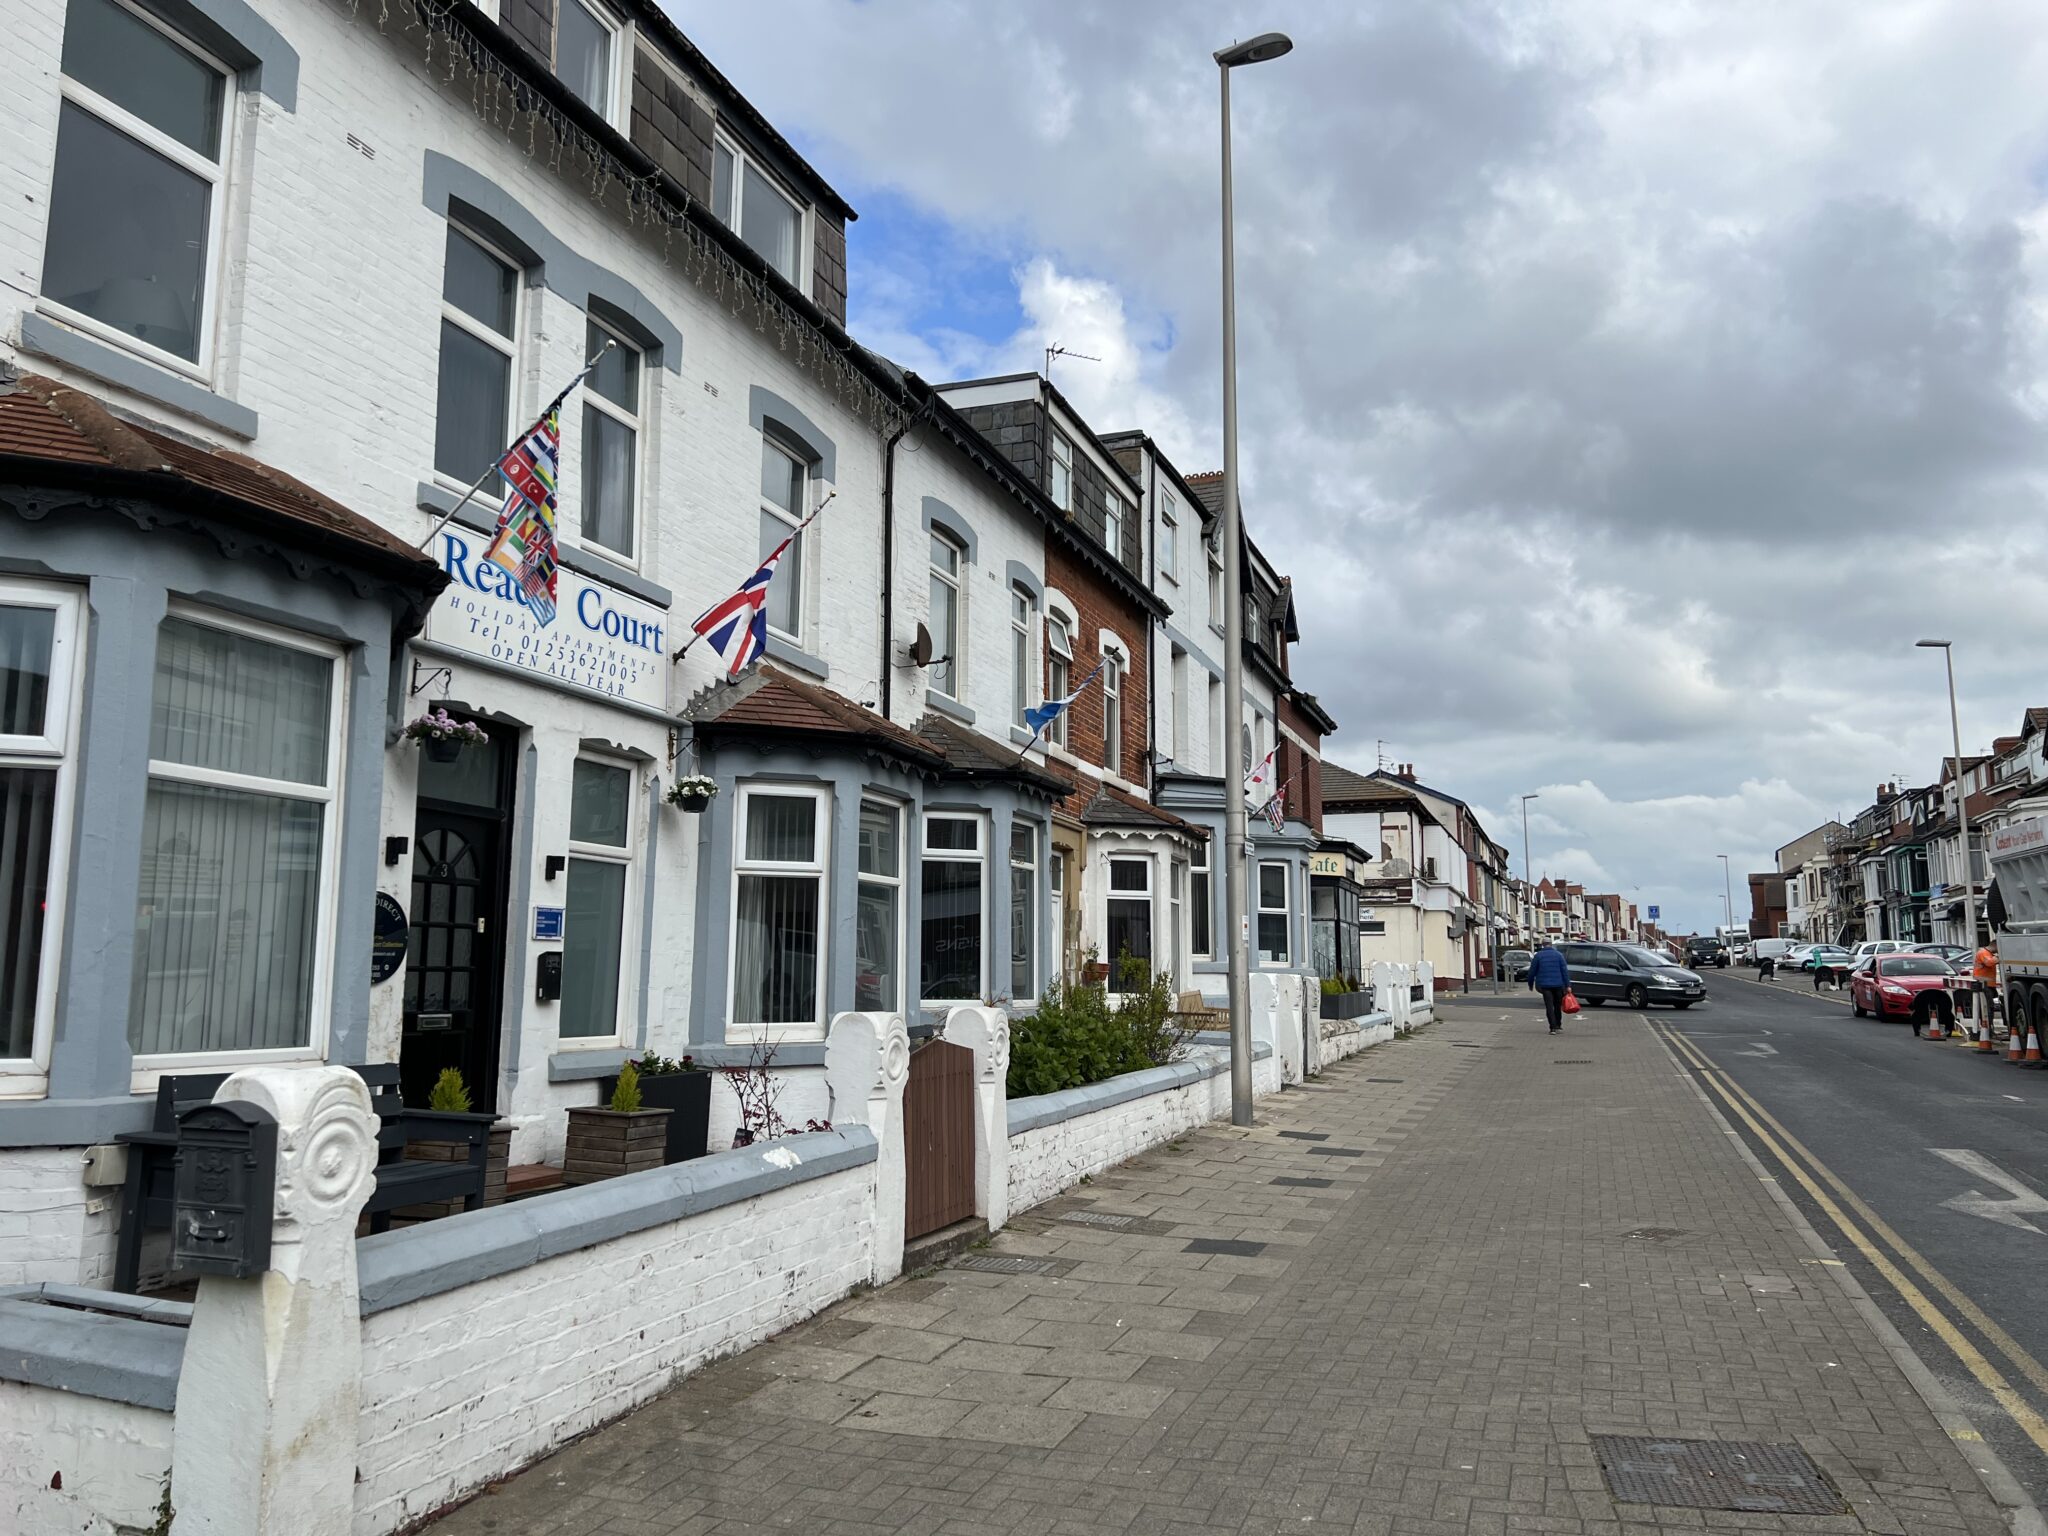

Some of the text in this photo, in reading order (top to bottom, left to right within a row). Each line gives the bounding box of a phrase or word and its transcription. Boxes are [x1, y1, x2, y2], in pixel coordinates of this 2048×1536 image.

[440, 532, 664, 656] Rea Court
[450, 596, 656, 675] HOLIDAY APARTMENTS
[469, 617, 638, 684] Tel. 01253621005
[491, 643, 626, 696] OPEN ALL YEAR
[440, 864, 448, 878] 3
[1309, 856, 1338, 872] afe
